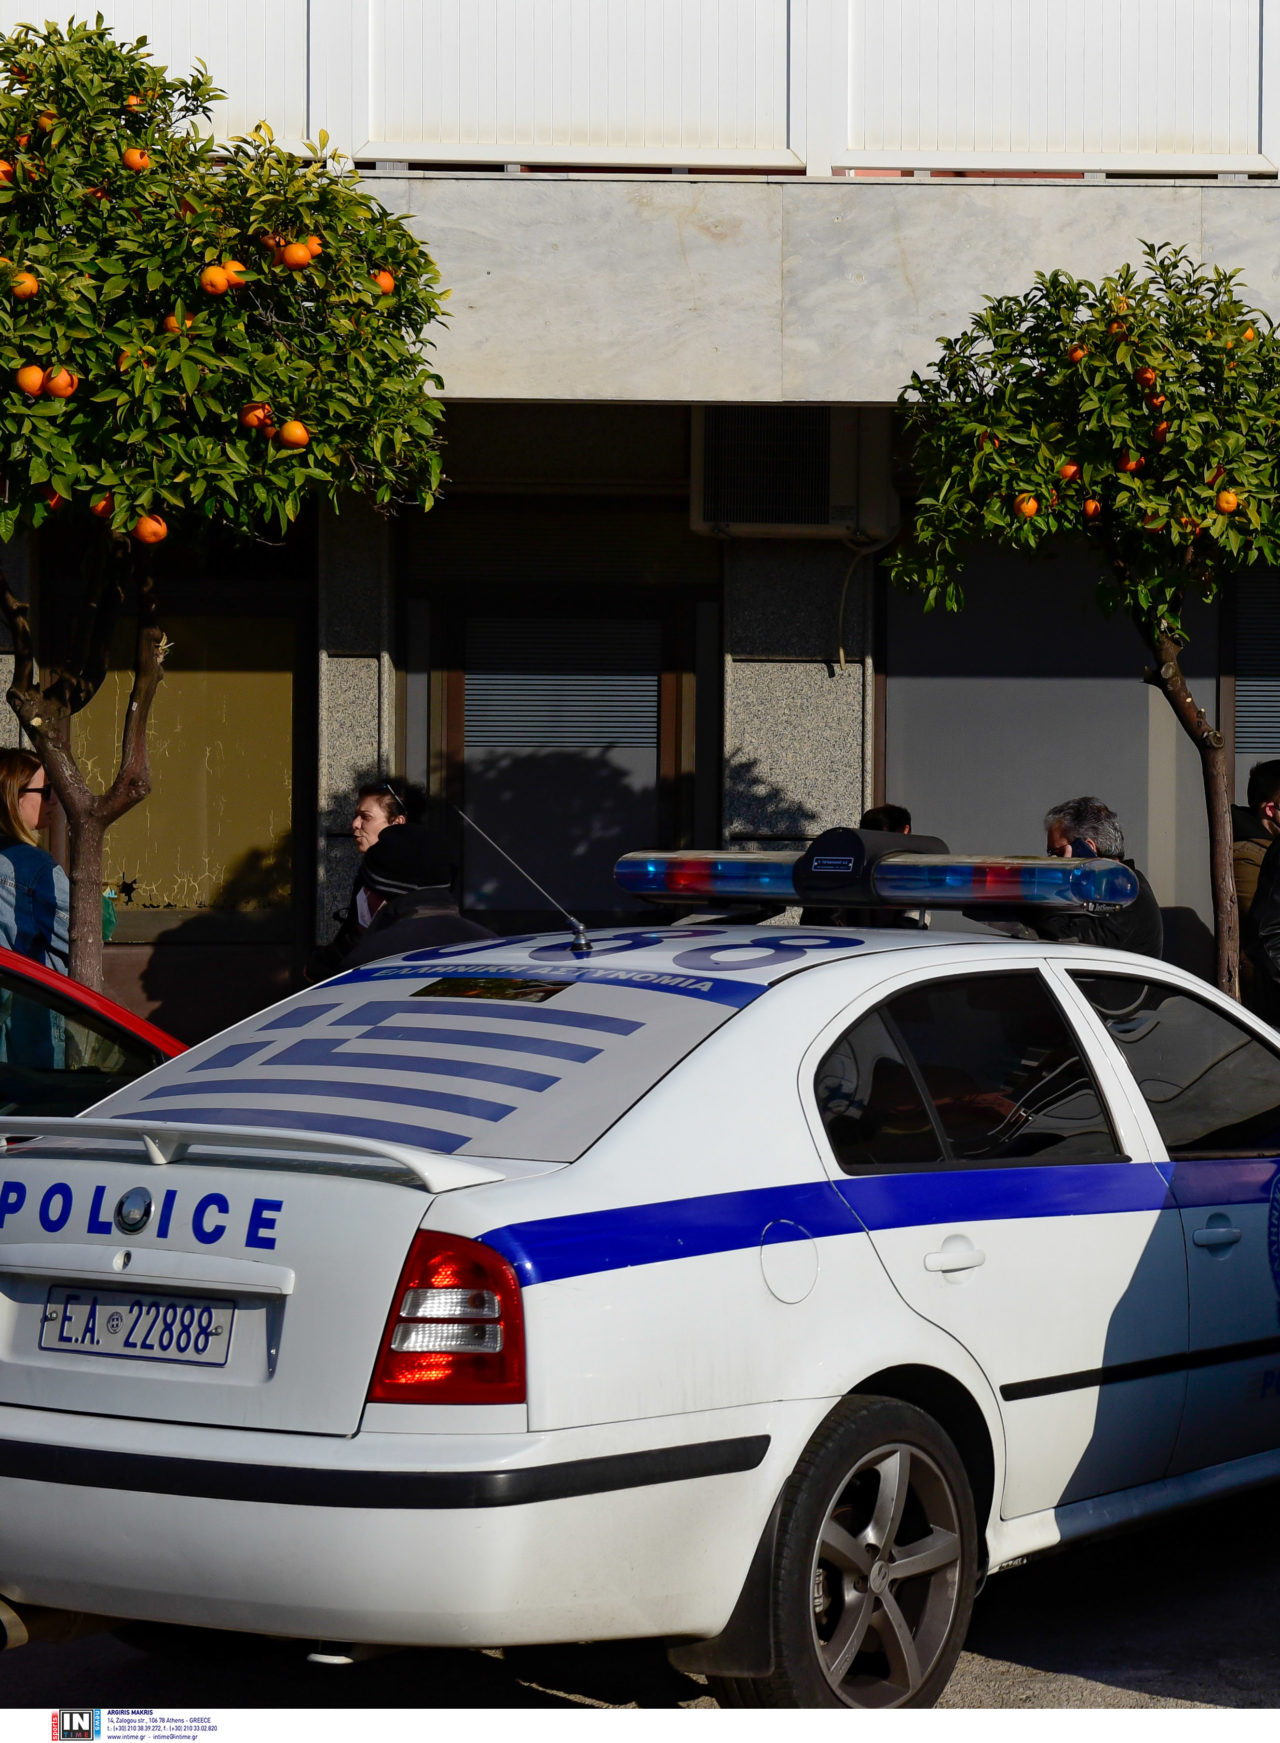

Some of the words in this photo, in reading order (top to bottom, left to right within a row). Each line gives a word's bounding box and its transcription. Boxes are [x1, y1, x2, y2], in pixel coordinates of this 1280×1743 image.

[531, 964, 714, 992] ΑΣΤΥΝΟΜΙΑ
[0, 1181, 284, 1250] POLICE
[123, 1299, 214, 1355] 22888
